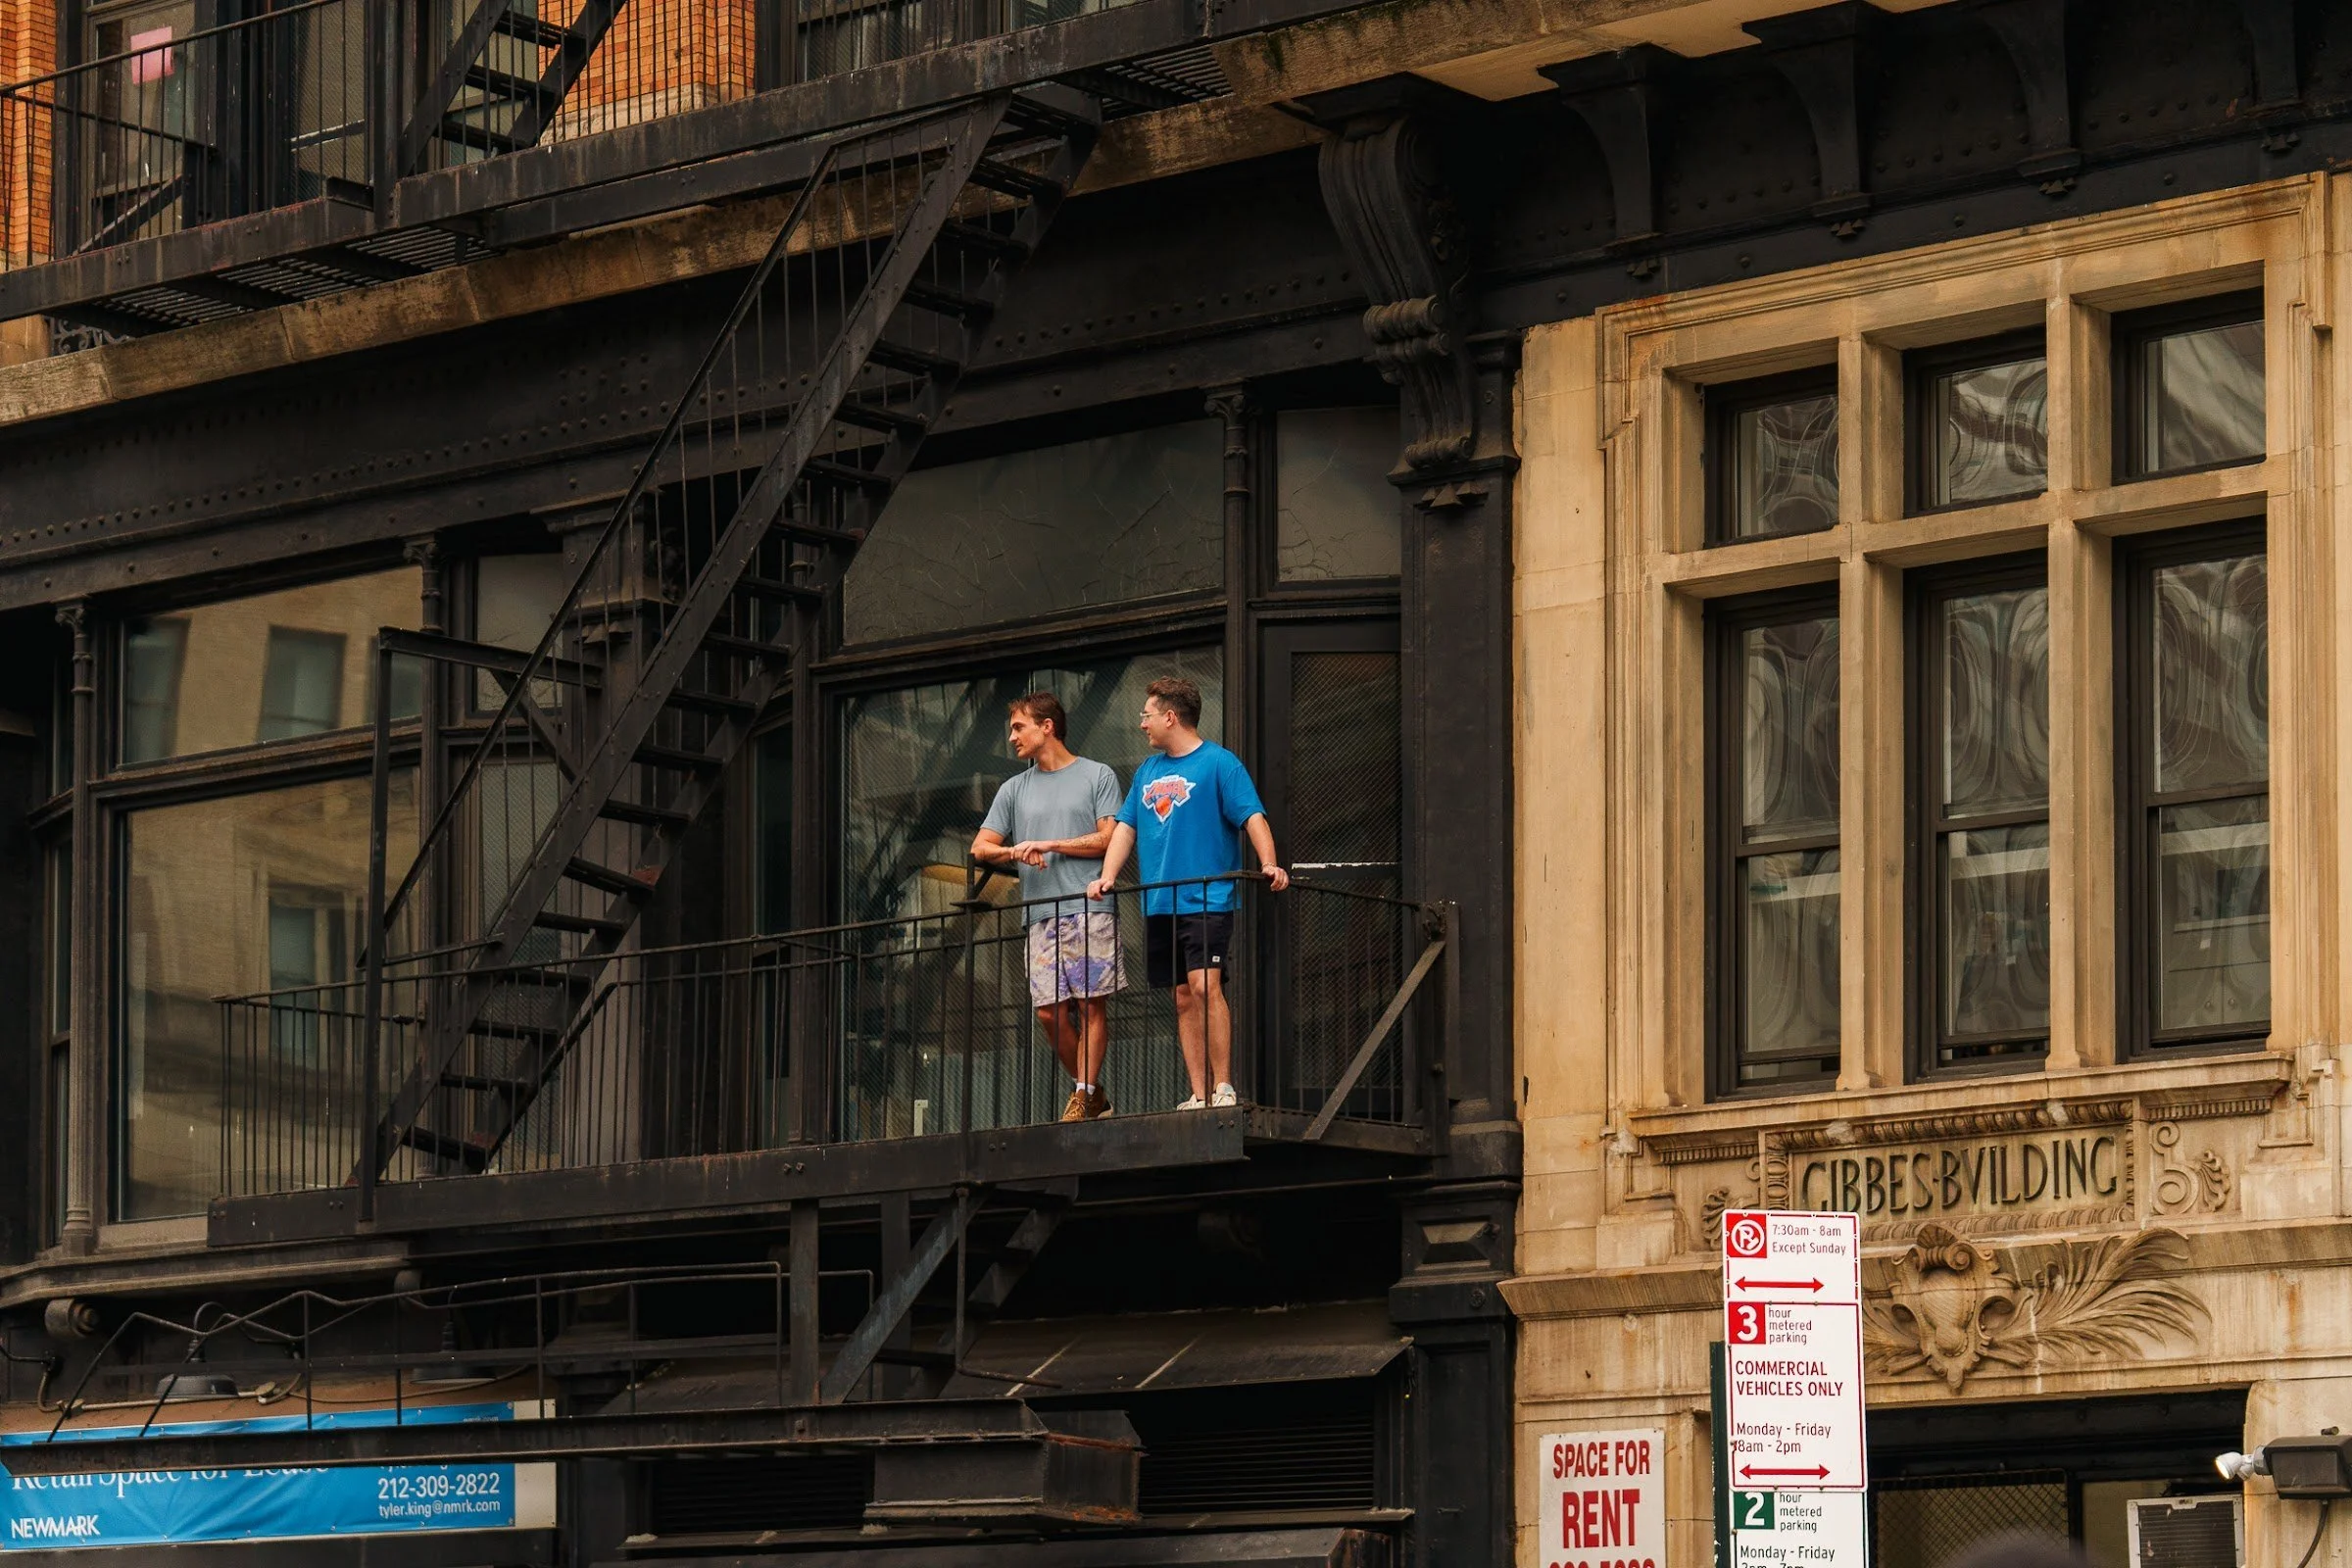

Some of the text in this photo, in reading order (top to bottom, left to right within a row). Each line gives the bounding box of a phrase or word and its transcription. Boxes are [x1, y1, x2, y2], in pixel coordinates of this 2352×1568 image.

[1773, 1225, 1809, 1236] 7:30am
[1820, 1225, 1841, 1237] 8am
[1772, 1242, 1846, 1255] Except Sunday
[1768, 1307, 1791, 1318] hour
[1737, 1304, 1758, 1342] 3
[1769, 1320, 1812, 1331] metered
[1769, 1333, 1807, 1345] parking
[1736, 1360, 1828, 1376] COMMERCIAL
[1737, 1381, 1843, 1396] VEHICLES ONLY
[1737, 1423, 1783, 1438] Monday
[1794, 1423, 1832, 1439] Friday
[1738, 1440, 1764, 1452] 8am
[1776, 1440, 1801, 1455] 2pm
[1552, 1440, 1650, 1479] SPACE FOR
[377, 1472, 500, 1499] 212-309-2822
[1780, 1493, 1802, 1503] hour
[378, 1499, 501, 1519] tyler.king@nmrk.com
[1744, 1492, 1765, 1526] 2
[1780, 1506, 1822, 1517] metered
[11, 1514, 101, 1539] NEWMARK
[1562, 1489, 1641, 1549] RENT
[1780, 1520, 1817, 1533] parking
[1740, 1545, 1787, 1561] Monday
[1798, 1545, 1835, 1562] Friday
